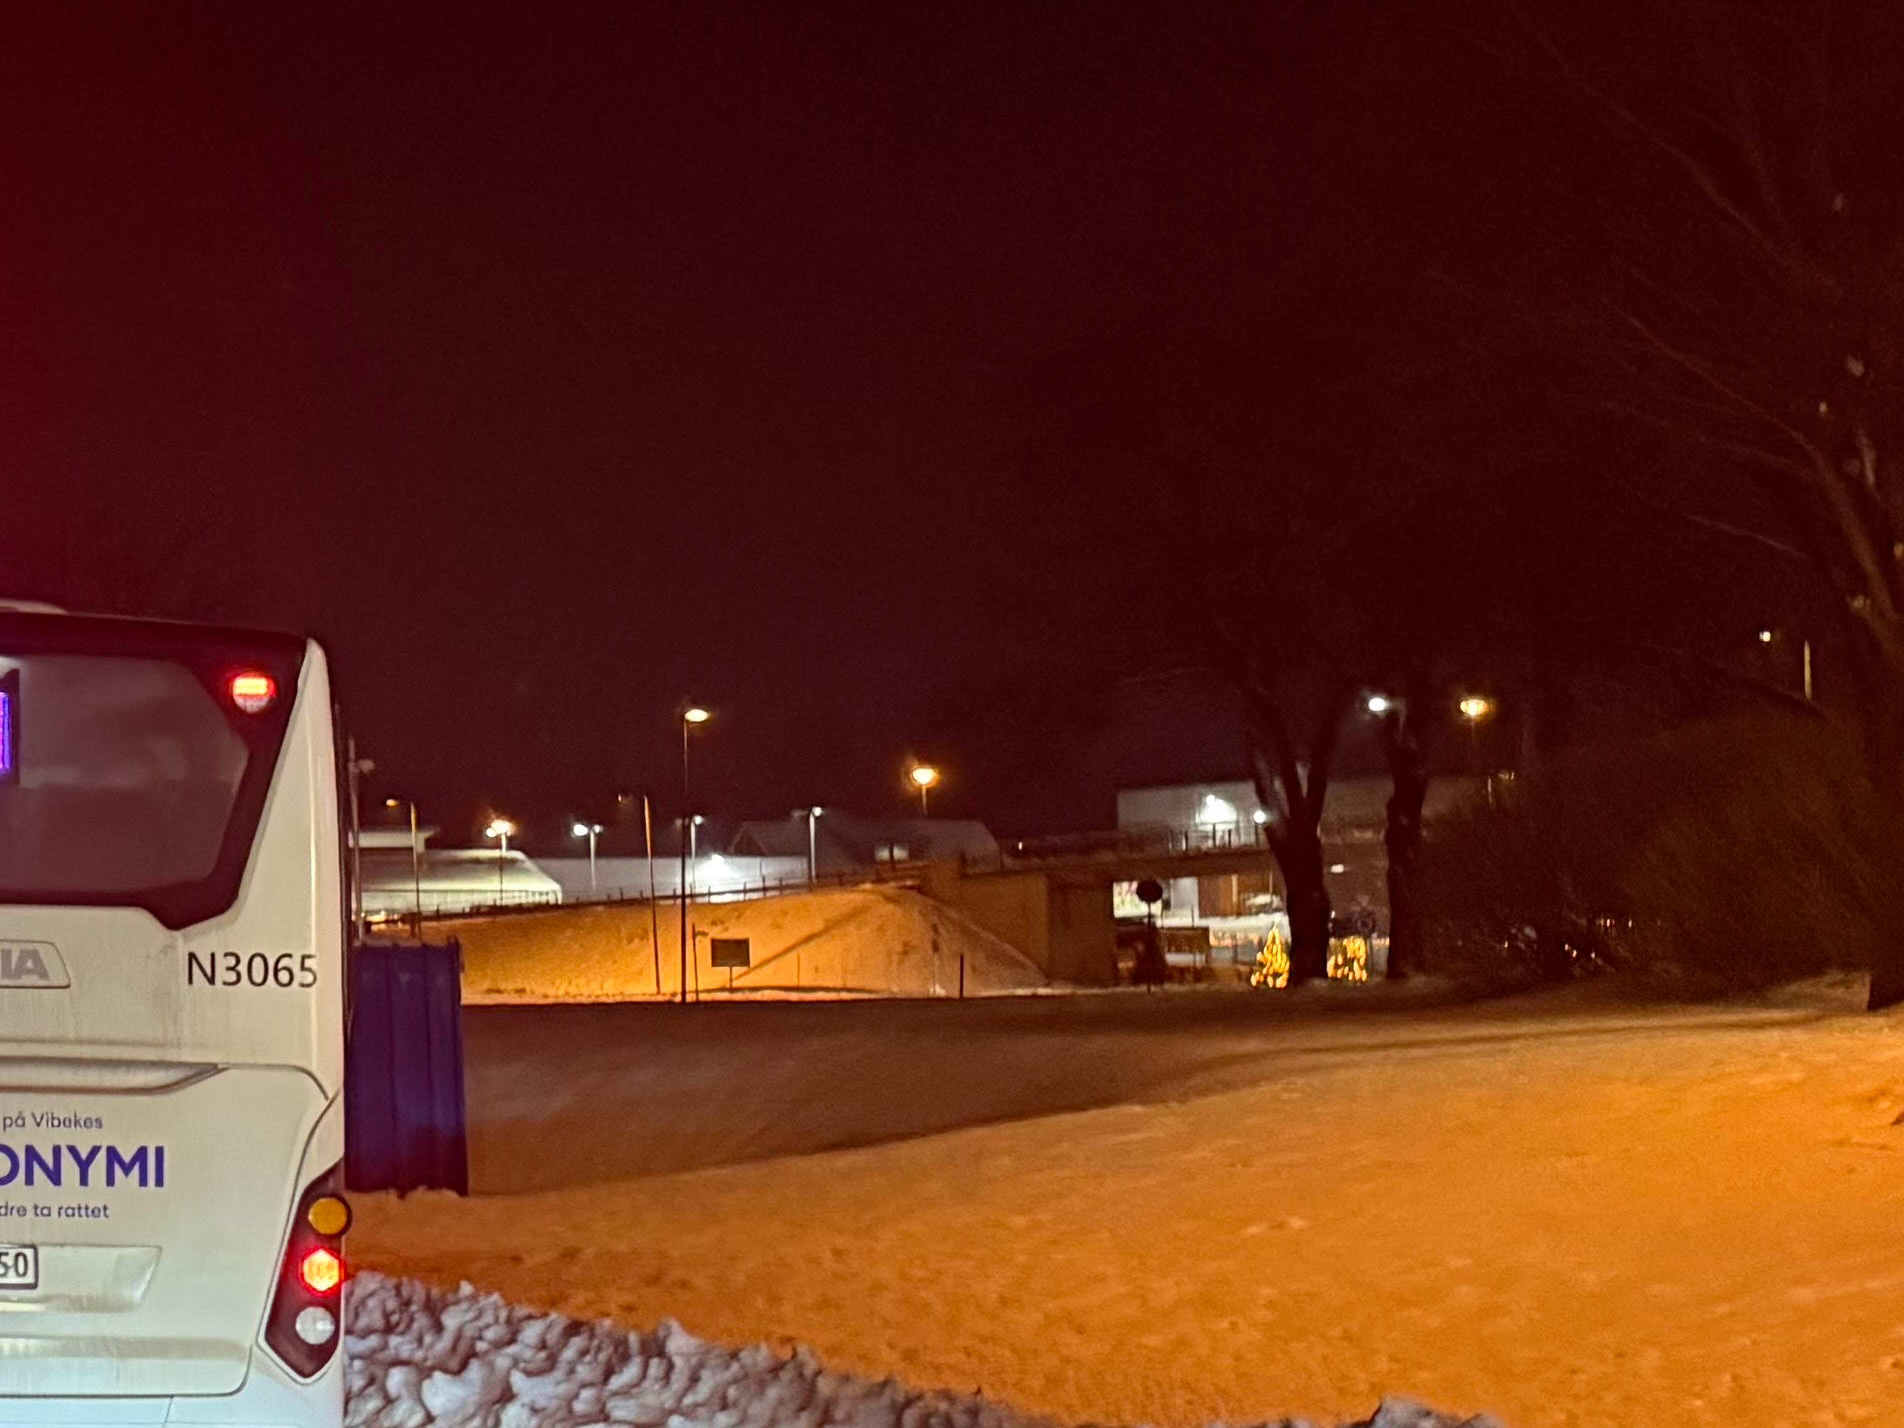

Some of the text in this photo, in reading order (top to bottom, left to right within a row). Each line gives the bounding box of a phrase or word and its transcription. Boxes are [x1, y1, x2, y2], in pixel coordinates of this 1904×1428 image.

[186, 951, 319, 989] N3065
[3, 1111, 27, 1133] på
[30, 1111, 104, 1130] Vibekes
[33, 1202, 53, 1219] ta
[57, 1203, 110, 1220] rattet
